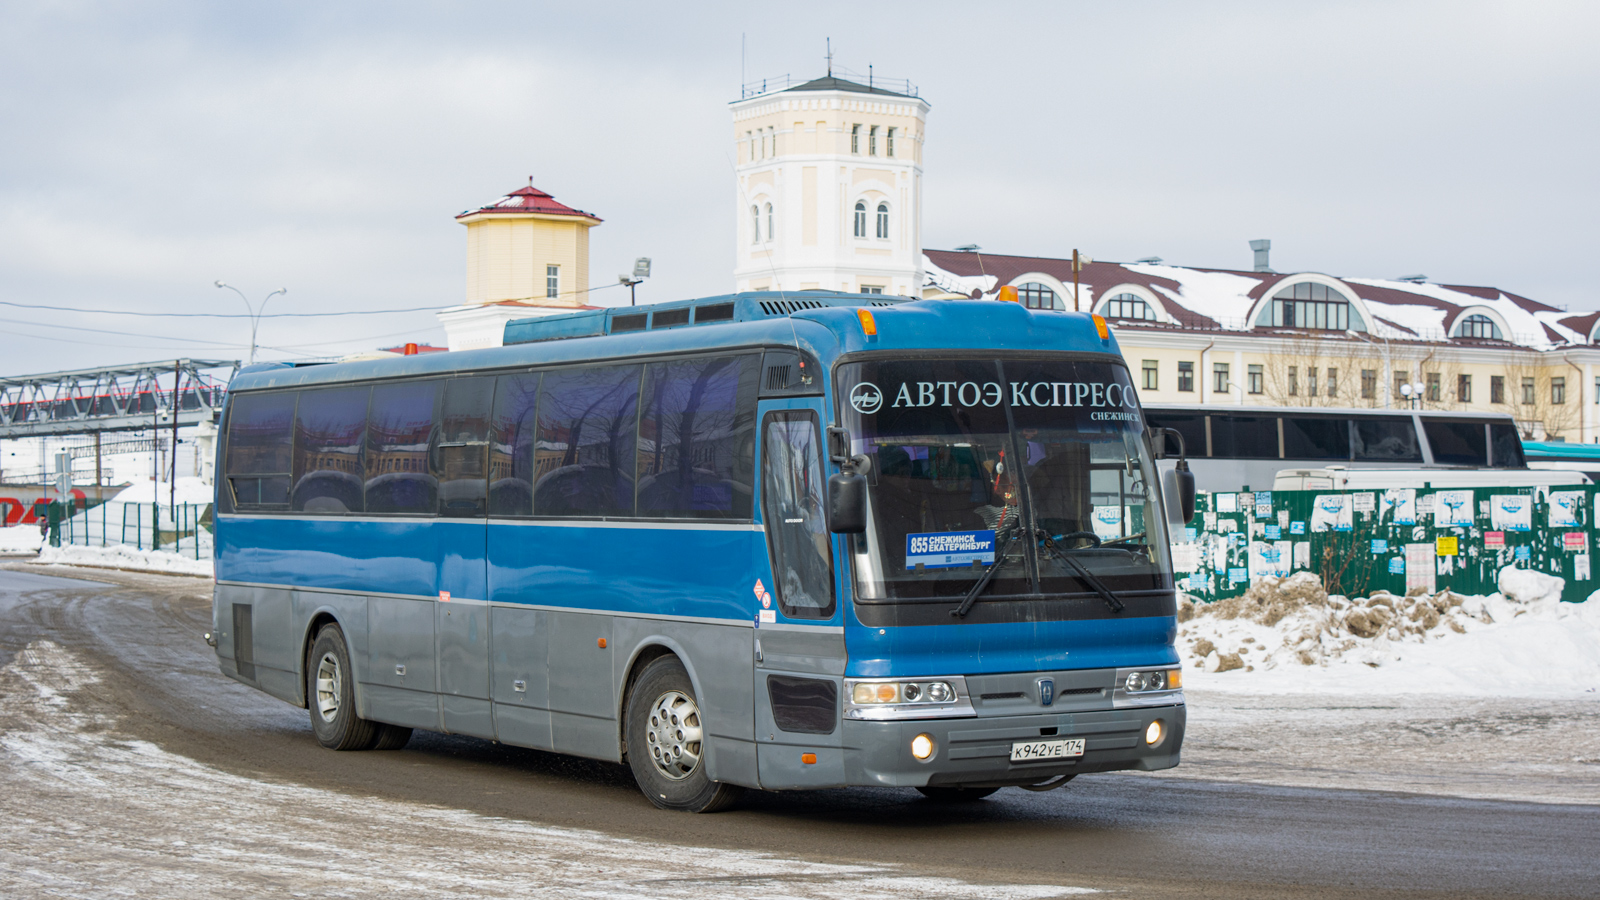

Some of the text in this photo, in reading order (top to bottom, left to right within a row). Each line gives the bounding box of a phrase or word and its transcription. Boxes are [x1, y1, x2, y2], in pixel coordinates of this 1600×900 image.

[891, 381, 1138, 409] АВТОЭКСПРЕСС
[1090, 411, 1139, 422] СНЕЖИНСК
[911, 535, 975, 553] 855 СНЕЖИНСК
[929, 541, 991, 552] ЕКАТЕРИНБУРГ
[1015, 741, 1082, 758] К942УЕ 174
